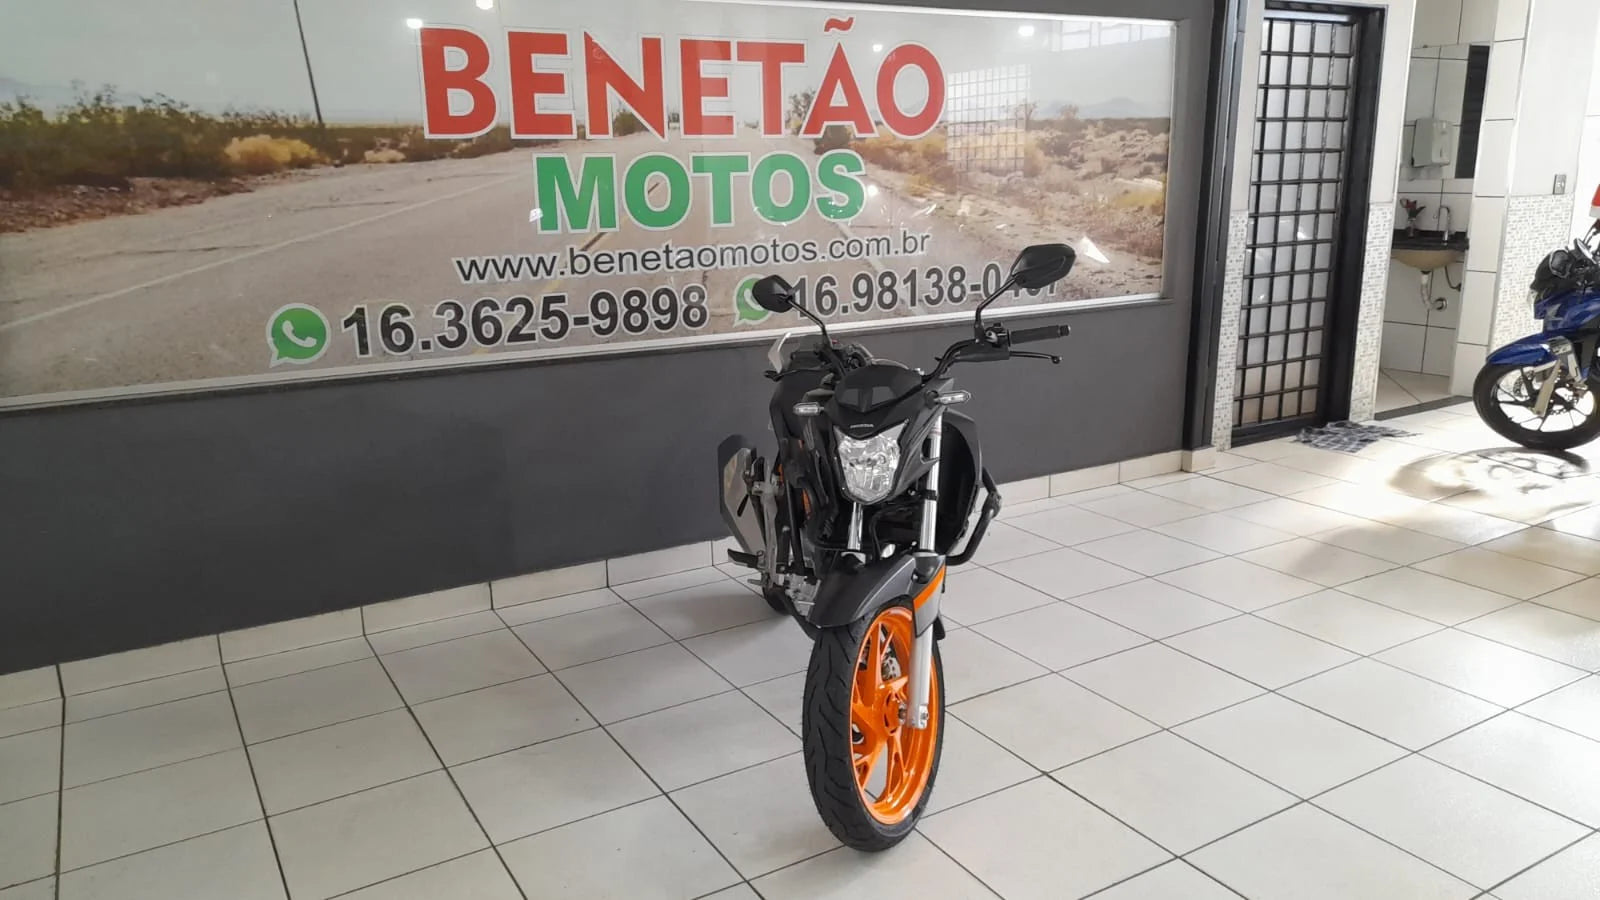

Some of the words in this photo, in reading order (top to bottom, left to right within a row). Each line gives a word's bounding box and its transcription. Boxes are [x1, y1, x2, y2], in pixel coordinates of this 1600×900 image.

[422, 18, 945, 138] BENETÃO
[535, 151, 866, 233] MOTOS
[455, 230, 931, 282] www.benetaomotos.com.br
[795, 263, 1057, 315] 16.98138-0
[343, 285, 707, 356] 16.3625-9898
